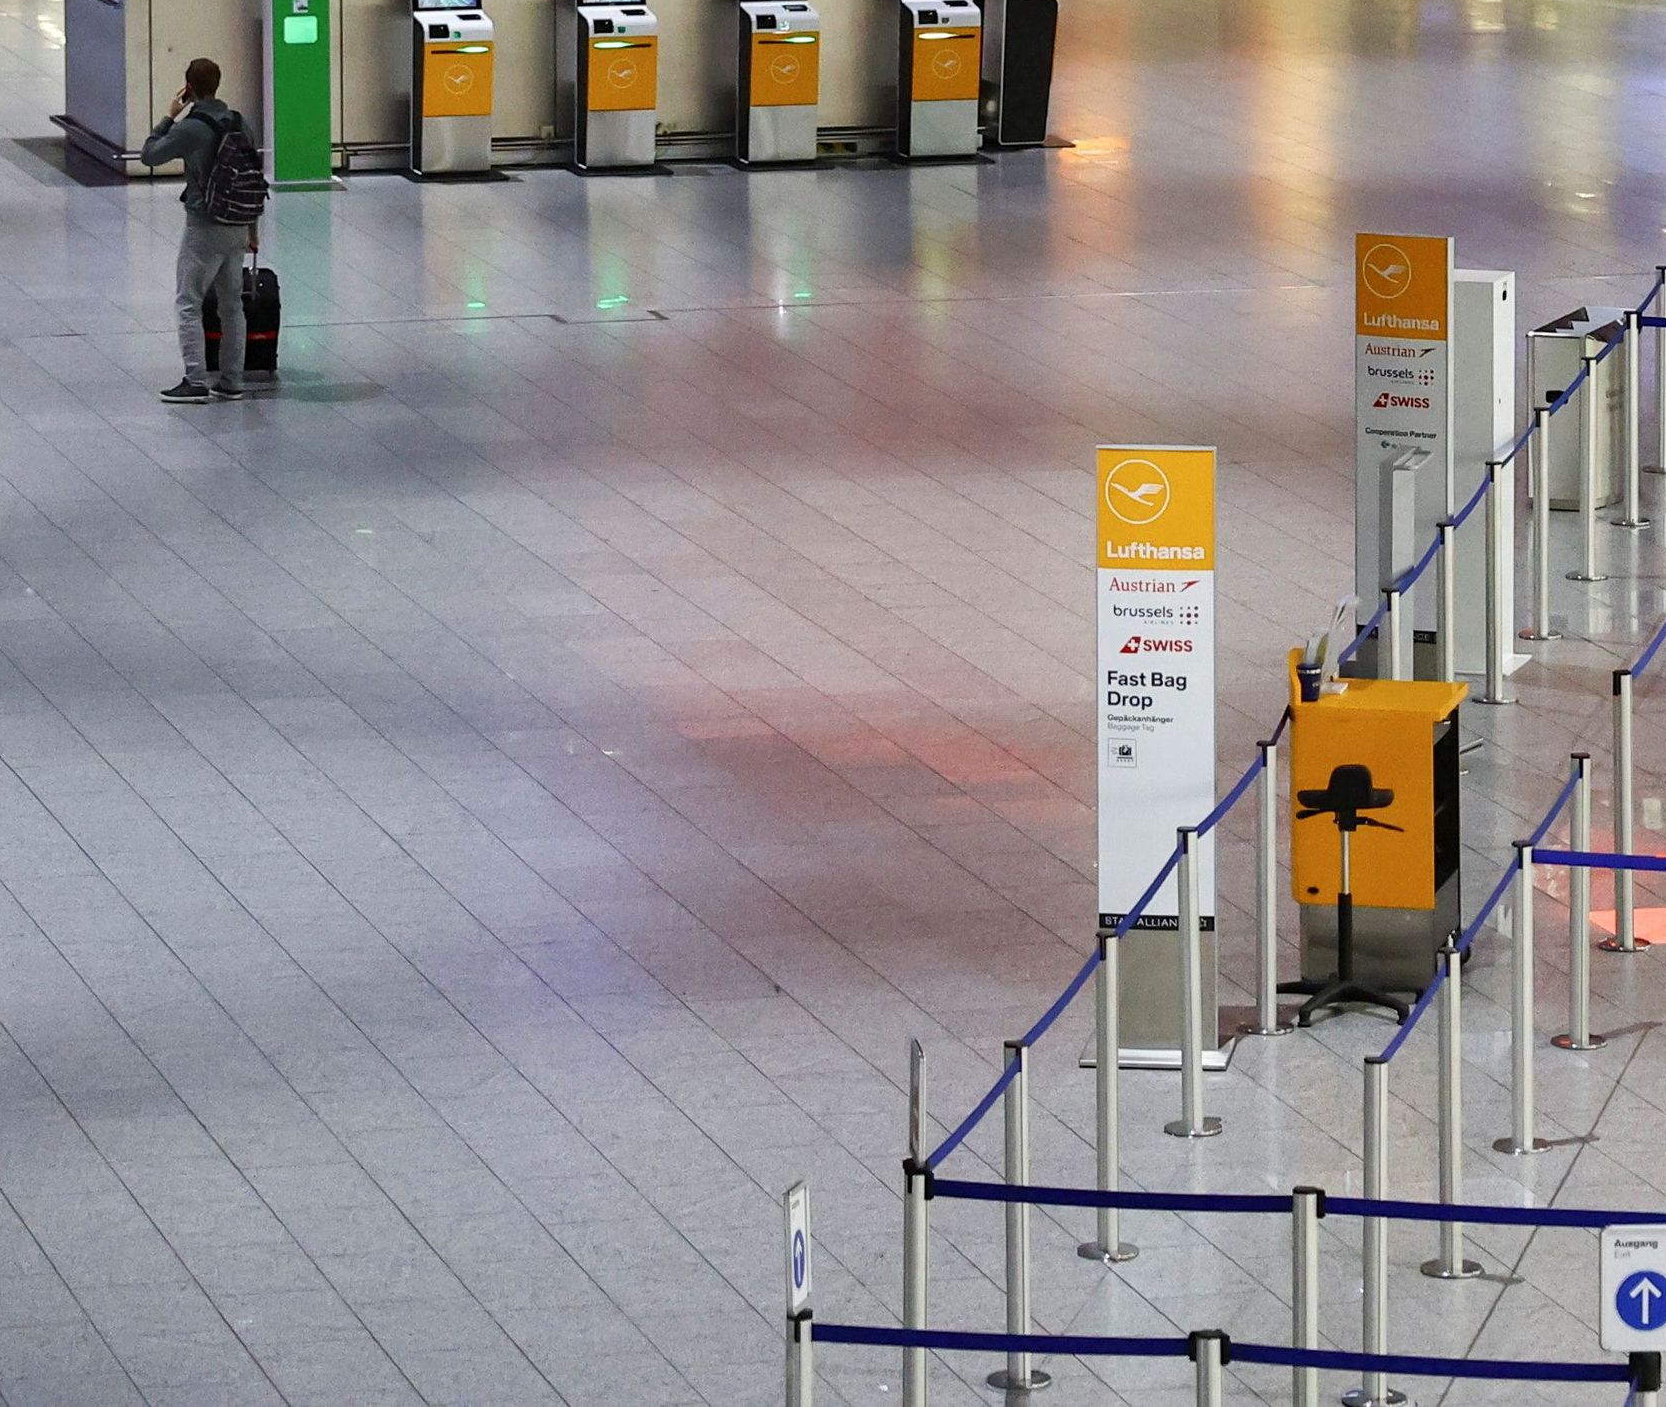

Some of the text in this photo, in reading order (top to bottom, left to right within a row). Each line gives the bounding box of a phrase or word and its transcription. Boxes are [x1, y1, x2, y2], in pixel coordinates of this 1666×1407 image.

[1364, 311, 1439, 331] Lufthansa
[1365, 343, 1416, 358] Austrian
[1367, 365, 1415, 379] brussels
[1390, 396, 1430, 409] SWISS
[1106, 541, 1205, 559] Lufthansa
[1109, 576, 1176, 593] Austrian
[1113, 604, 1174, 619] brussels
[1143, 639, 1193, 652] SWISS
[1107, 670, 1187, 690] Fast Bag
[1107, 691, 1153, 711] Drop
[1614, 1239, 1658, 1249] Ausgang
